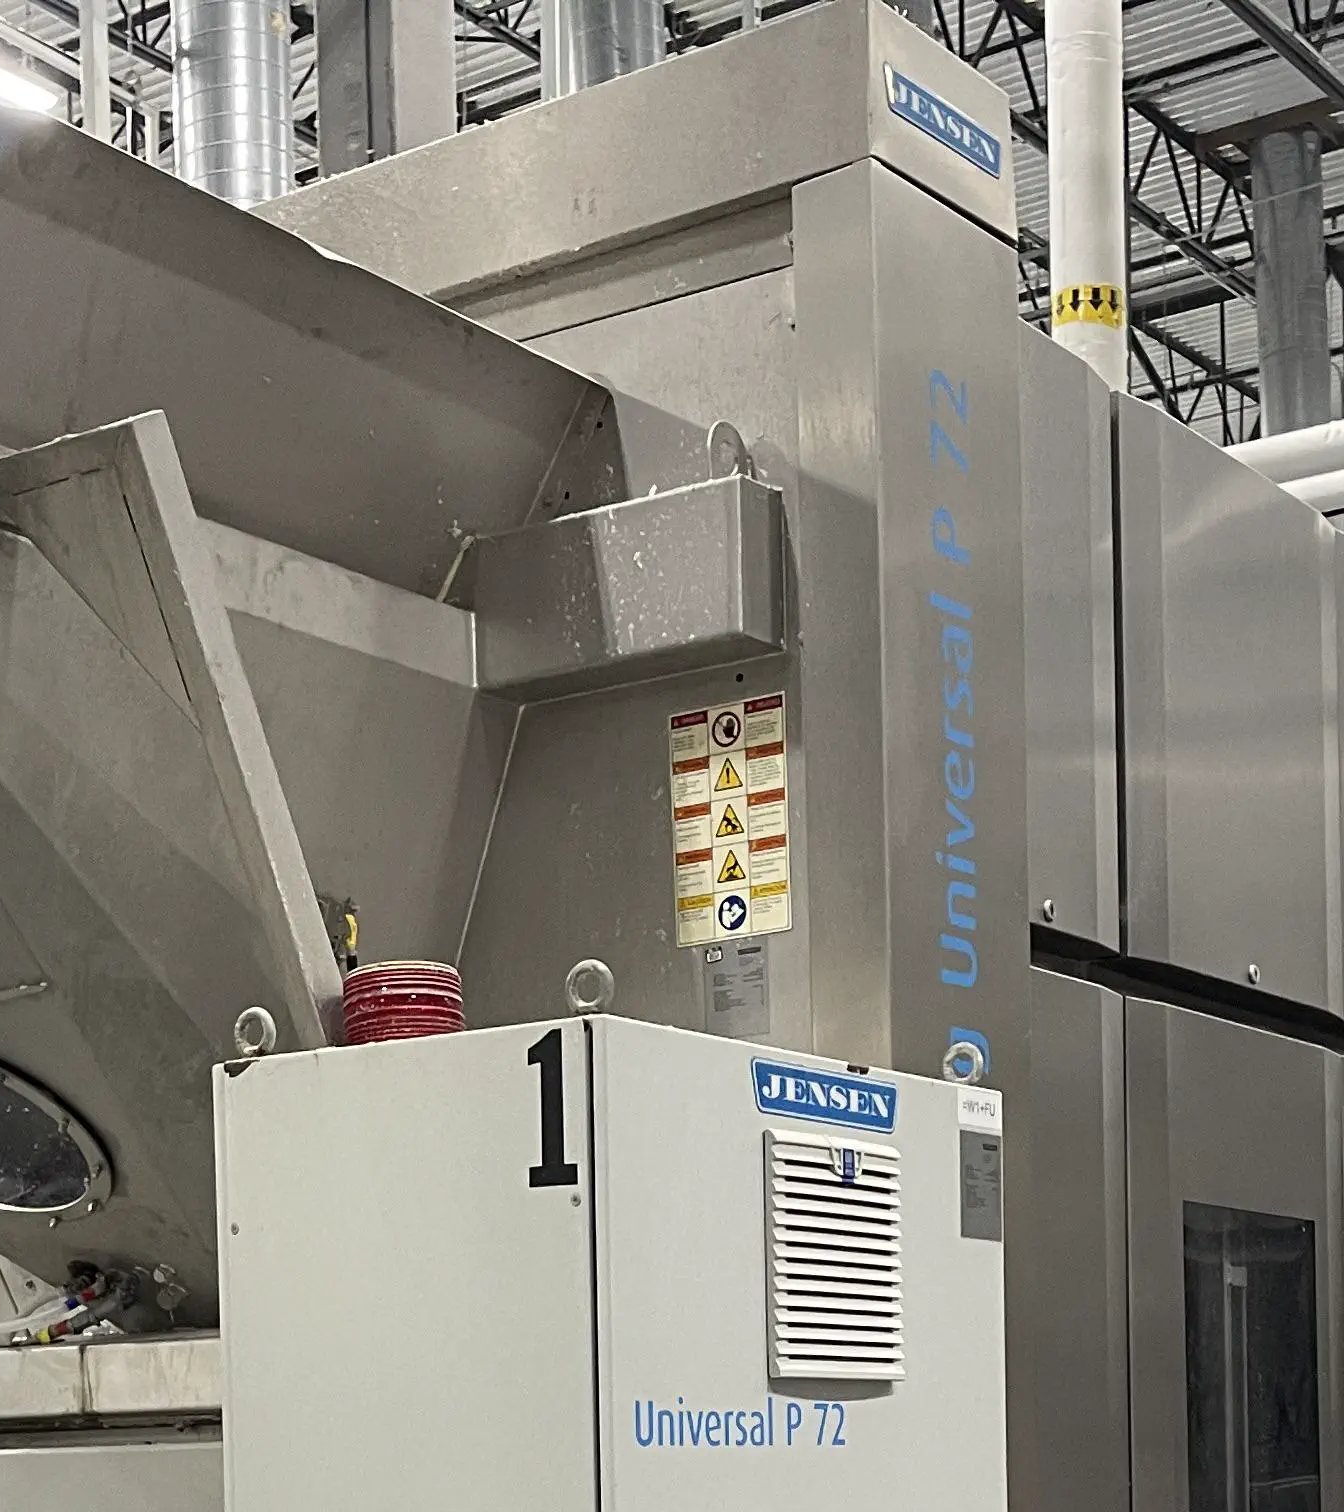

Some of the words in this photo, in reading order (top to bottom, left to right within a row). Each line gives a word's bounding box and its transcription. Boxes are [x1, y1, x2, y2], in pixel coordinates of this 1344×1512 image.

[895, 80, 995, 163] JENSEN
[928, 368, 970, 473] 72
[930, 505, 973, 567] P
[929, 591, 979, 988] Universal
[527, 1028, 579, 1188] 1
[761, 1073, 891, 1119] JENSEN
[634, 1396, 775, 1447] Universal
[787, 1400, 803, 1446] P
[815, 1402, 847, 1447] 72
